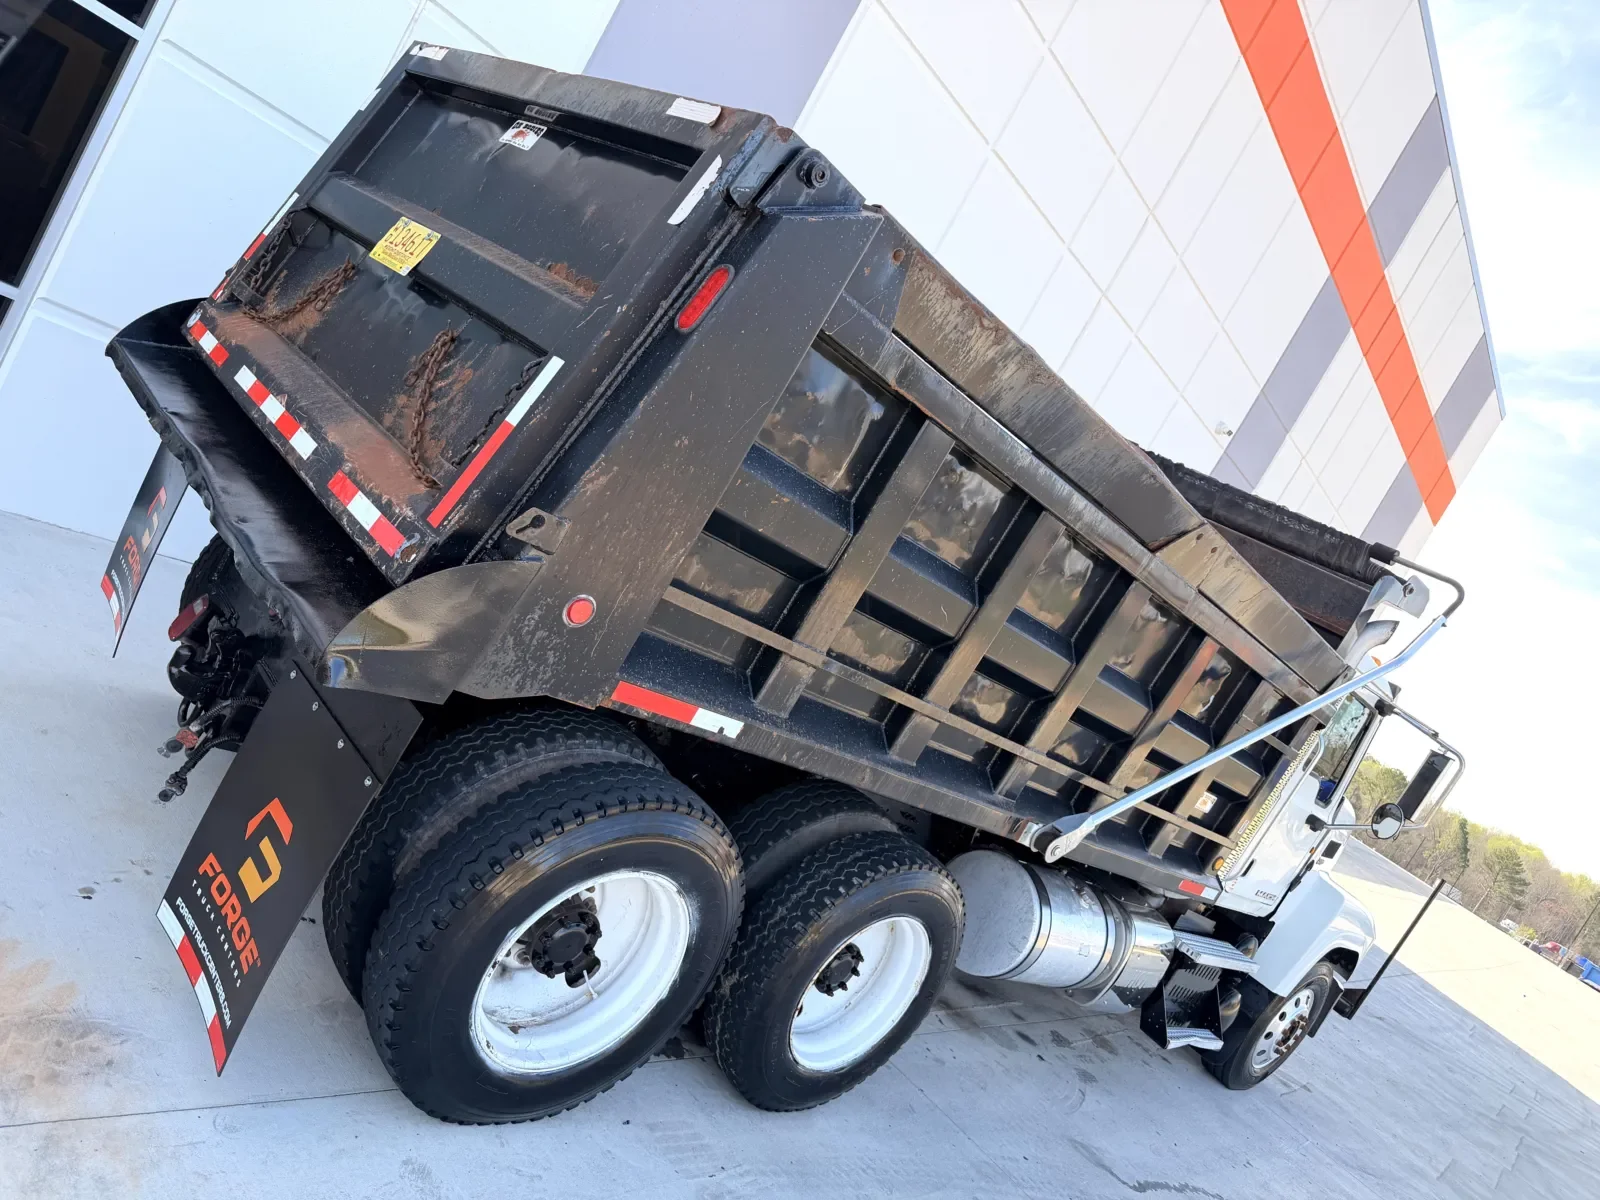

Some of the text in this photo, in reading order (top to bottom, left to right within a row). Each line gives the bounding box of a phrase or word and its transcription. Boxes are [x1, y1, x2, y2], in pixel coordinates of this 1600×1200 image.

[175, 896, 233, 1030] FORGETRUCKCENTERS.COM
[191, 878, 242, 989] TRUCK CENTERS
[197, 851, 258, 976] FORGE
